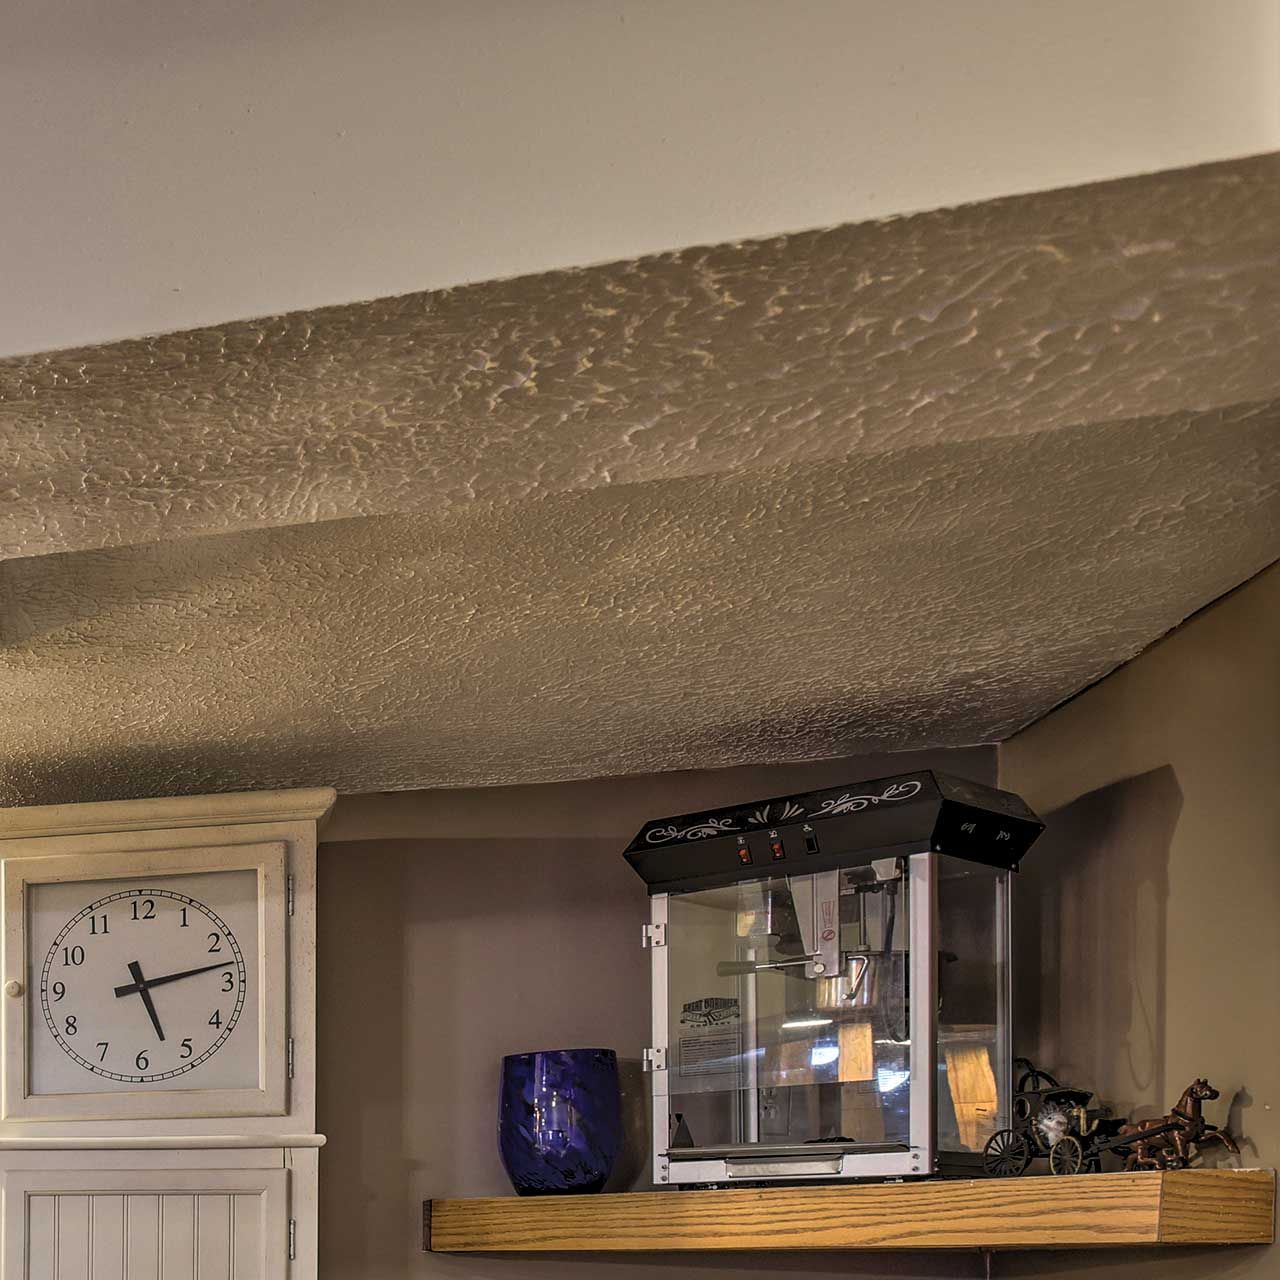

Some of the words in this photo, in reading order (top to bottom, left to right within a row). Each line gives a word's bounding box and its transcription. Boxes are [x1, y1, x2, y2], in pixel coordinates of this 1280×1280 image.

[129, 899, 157, 920] 12
[179, 907, 189, 928] 1
[89, 914, 110, 935] 11
[207, 932, 222, 953] 2
[62, 945, 85, 967] 10
[52, 981, 66, 1002] 9
[221, 971, 234, 993] 3
[65, 1015, 78, 1036] 8
[208, 1009, 223, 1029] 4
[96, 1042, 109, 1062] 7
[179, 1038, 193, 1059] 5
[135, 1049, 149, 1070] 6
